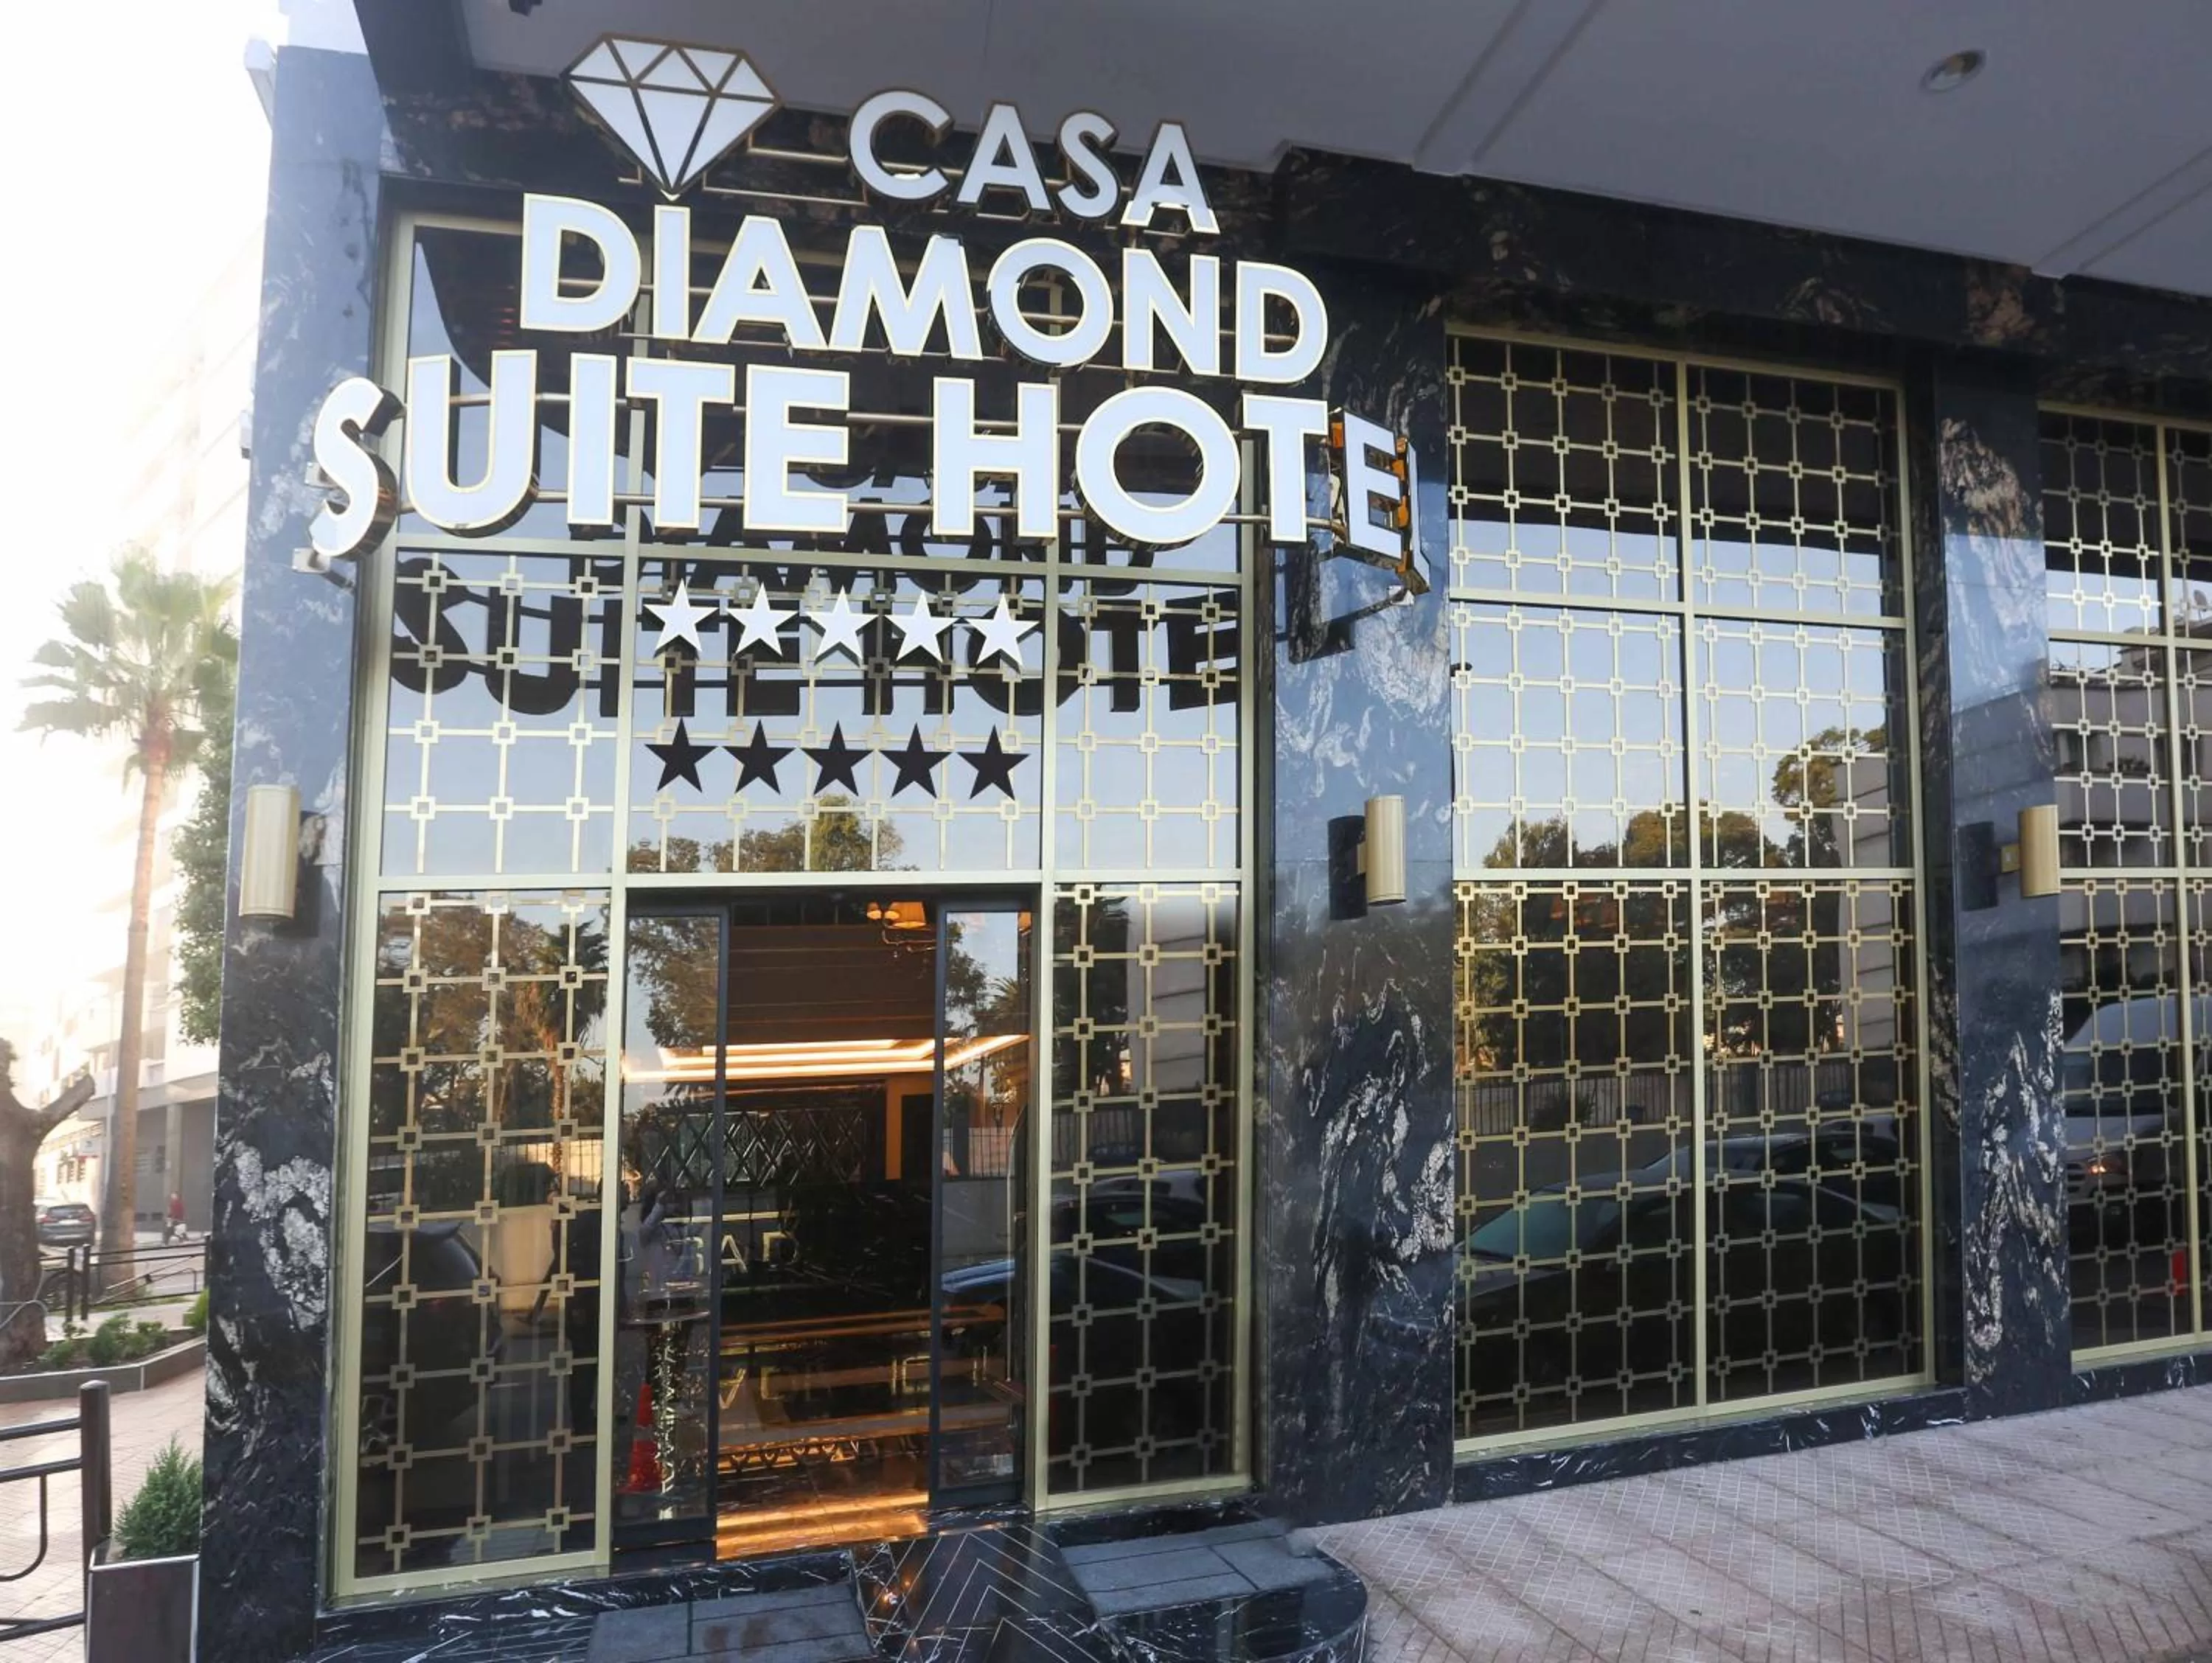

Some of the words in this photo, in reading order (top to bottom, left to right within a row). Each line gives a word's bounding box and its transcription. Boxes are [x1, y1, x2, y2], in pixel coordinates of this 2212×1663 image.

[847, 89, 1221, 235] CASA
[520, 192, 1329, 384] DIAMOND
[308, 349, 850, 557] SUITE
